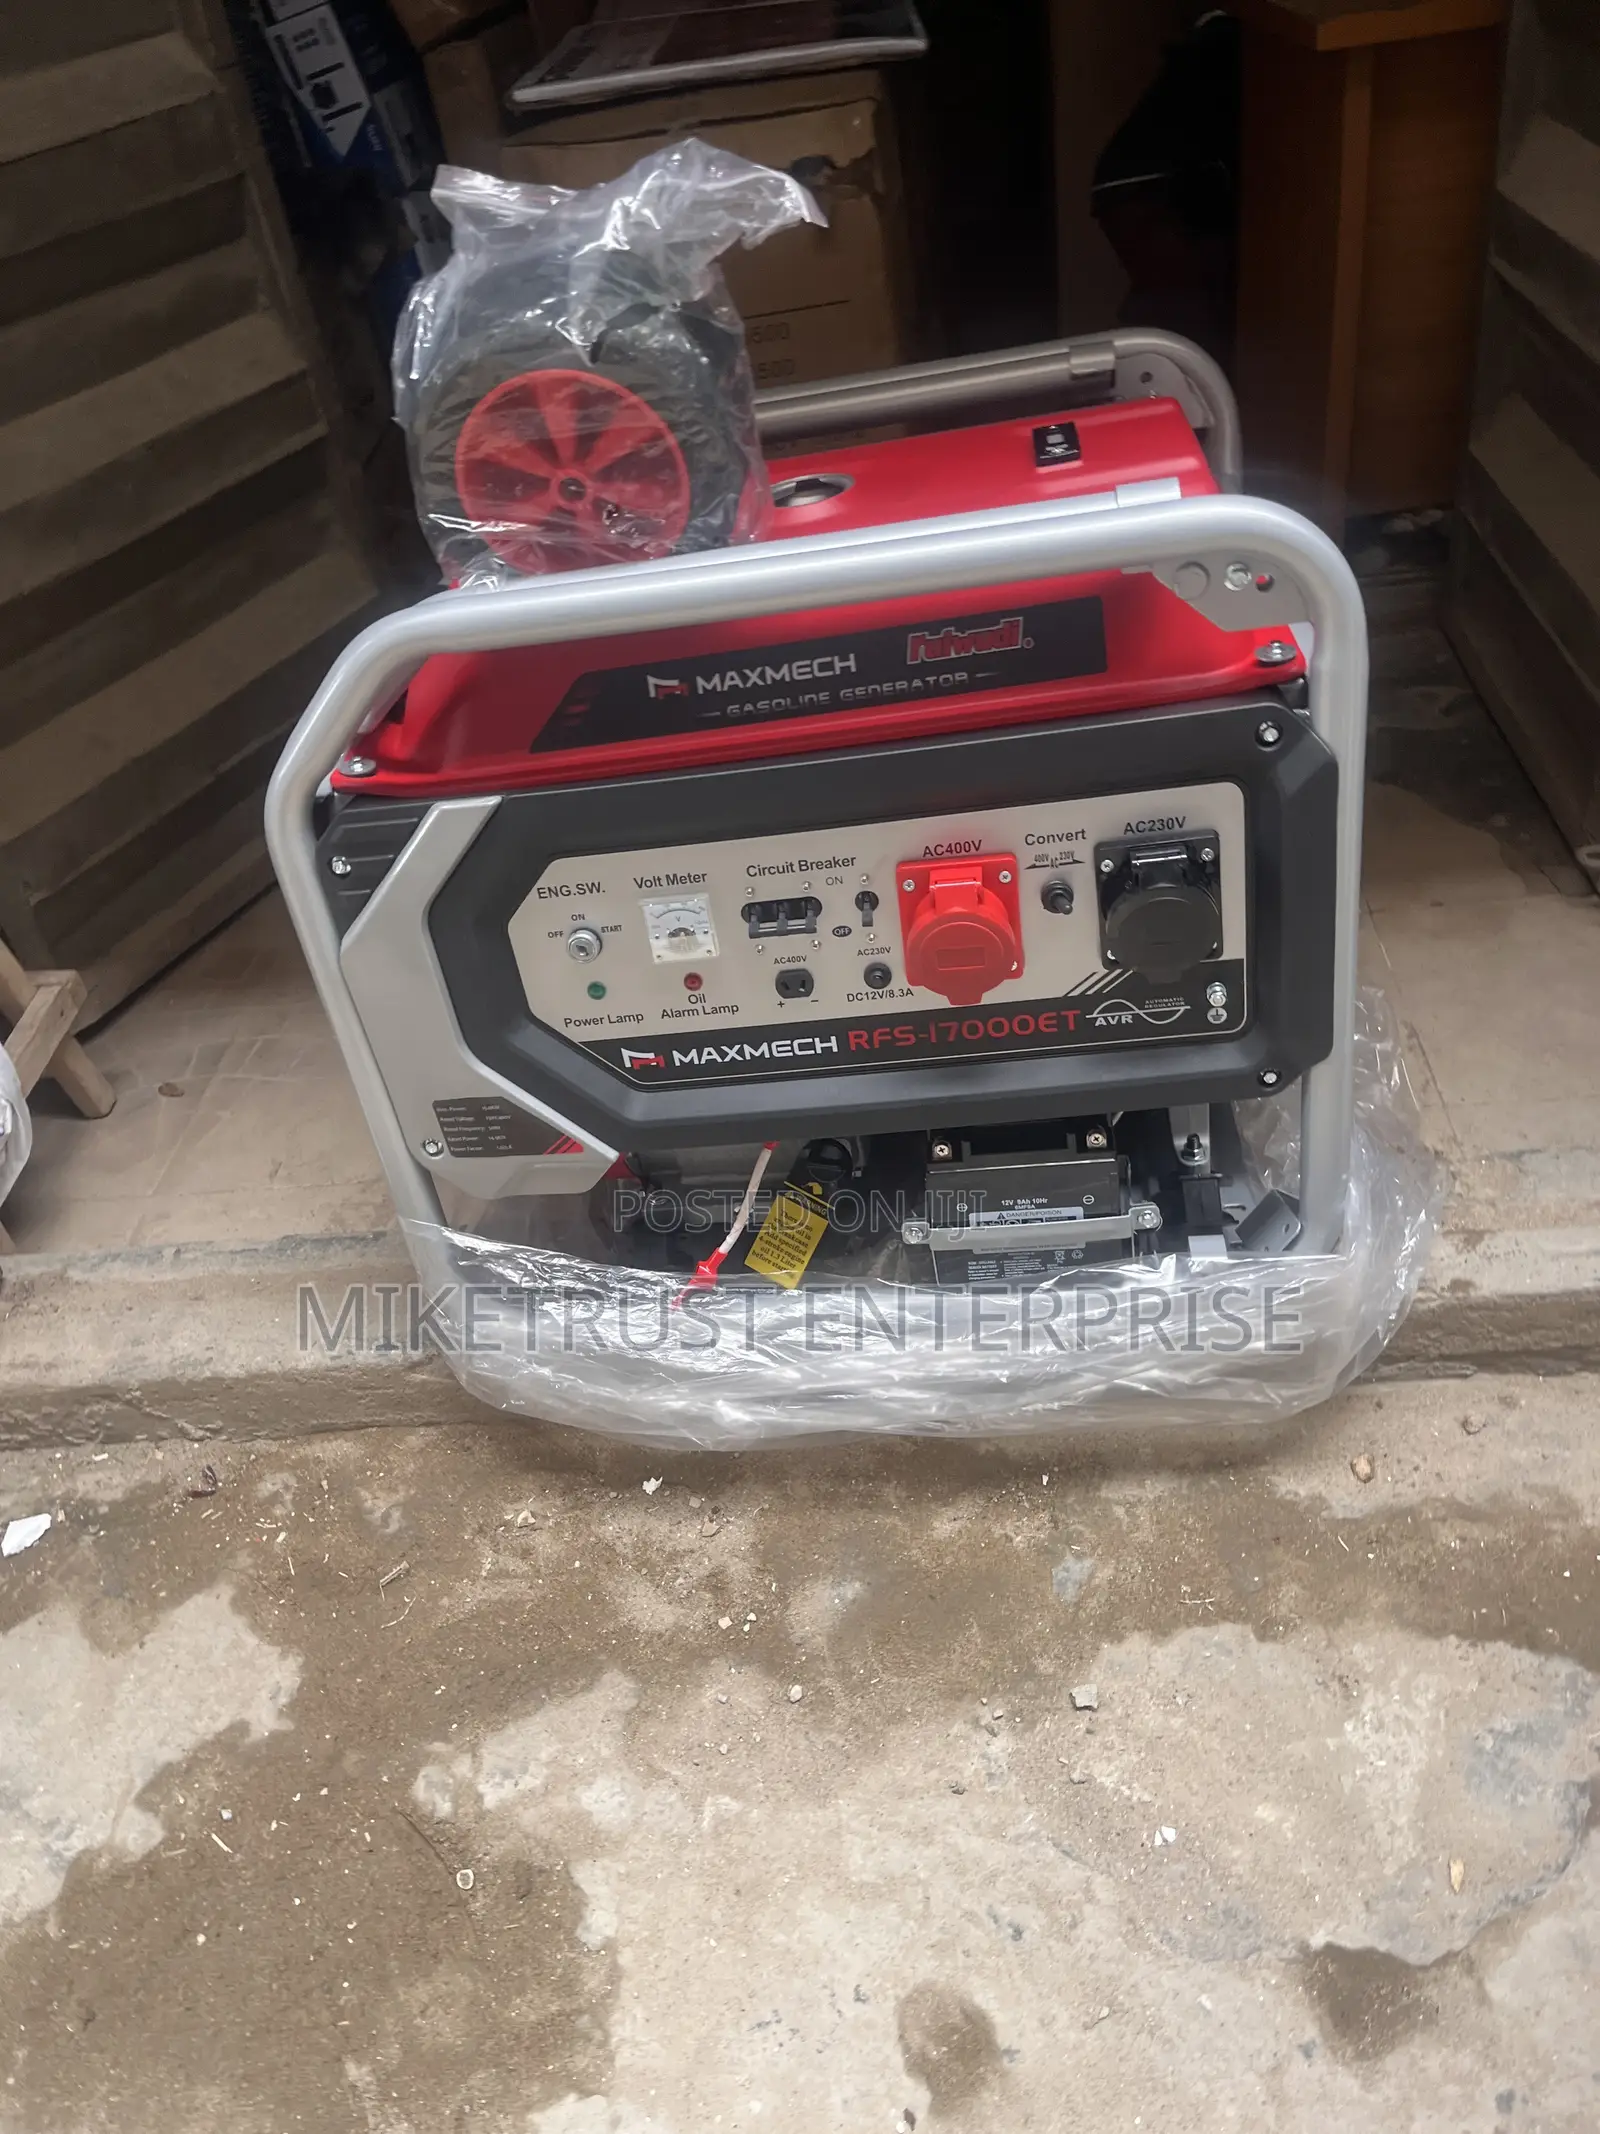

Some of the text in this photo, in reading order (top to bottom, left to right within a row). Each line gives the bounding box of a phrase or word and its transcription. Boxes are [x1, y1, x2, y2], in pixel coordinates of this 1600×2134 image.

[695, 653, 857, 695] MAXMECH
[726, 671, 969, 718] GASOLINE GENERATOR
[1123, 816, 1187, 835] AC230V
[1024, 828, 1087, 846] Convert
[922, 839, 983, 858] AC400V
[746, 855, 857, 878] Circuit Breaker
[633, 871, 708, 888] Volt Meter
[825, 876, 844, 886] ON
[536, 881, 606, 900] ENG.SW.
[547, 930, 564, 938] OFF
[600, 925, 623, 933] START
[833, 927, 851, 937] OFF
[857, 946, 892, 957] AC230V
[773, 955, 808, 965] AC400V
[687, 994, 707, 1005] Oil
[846, 988, 914, 1002] DC12V/8.3A
[660, 1004, 740, 1020] Alarm Lamp
[563, 1013, 645, 1029] Power Lamp
[1094, 1014, 1134, 1027] AVR
[672, 1036, 838, 1067] MAXMECH
[779, 1238, 808, 1257] specified
[752, 1250, 771, 1265] before
